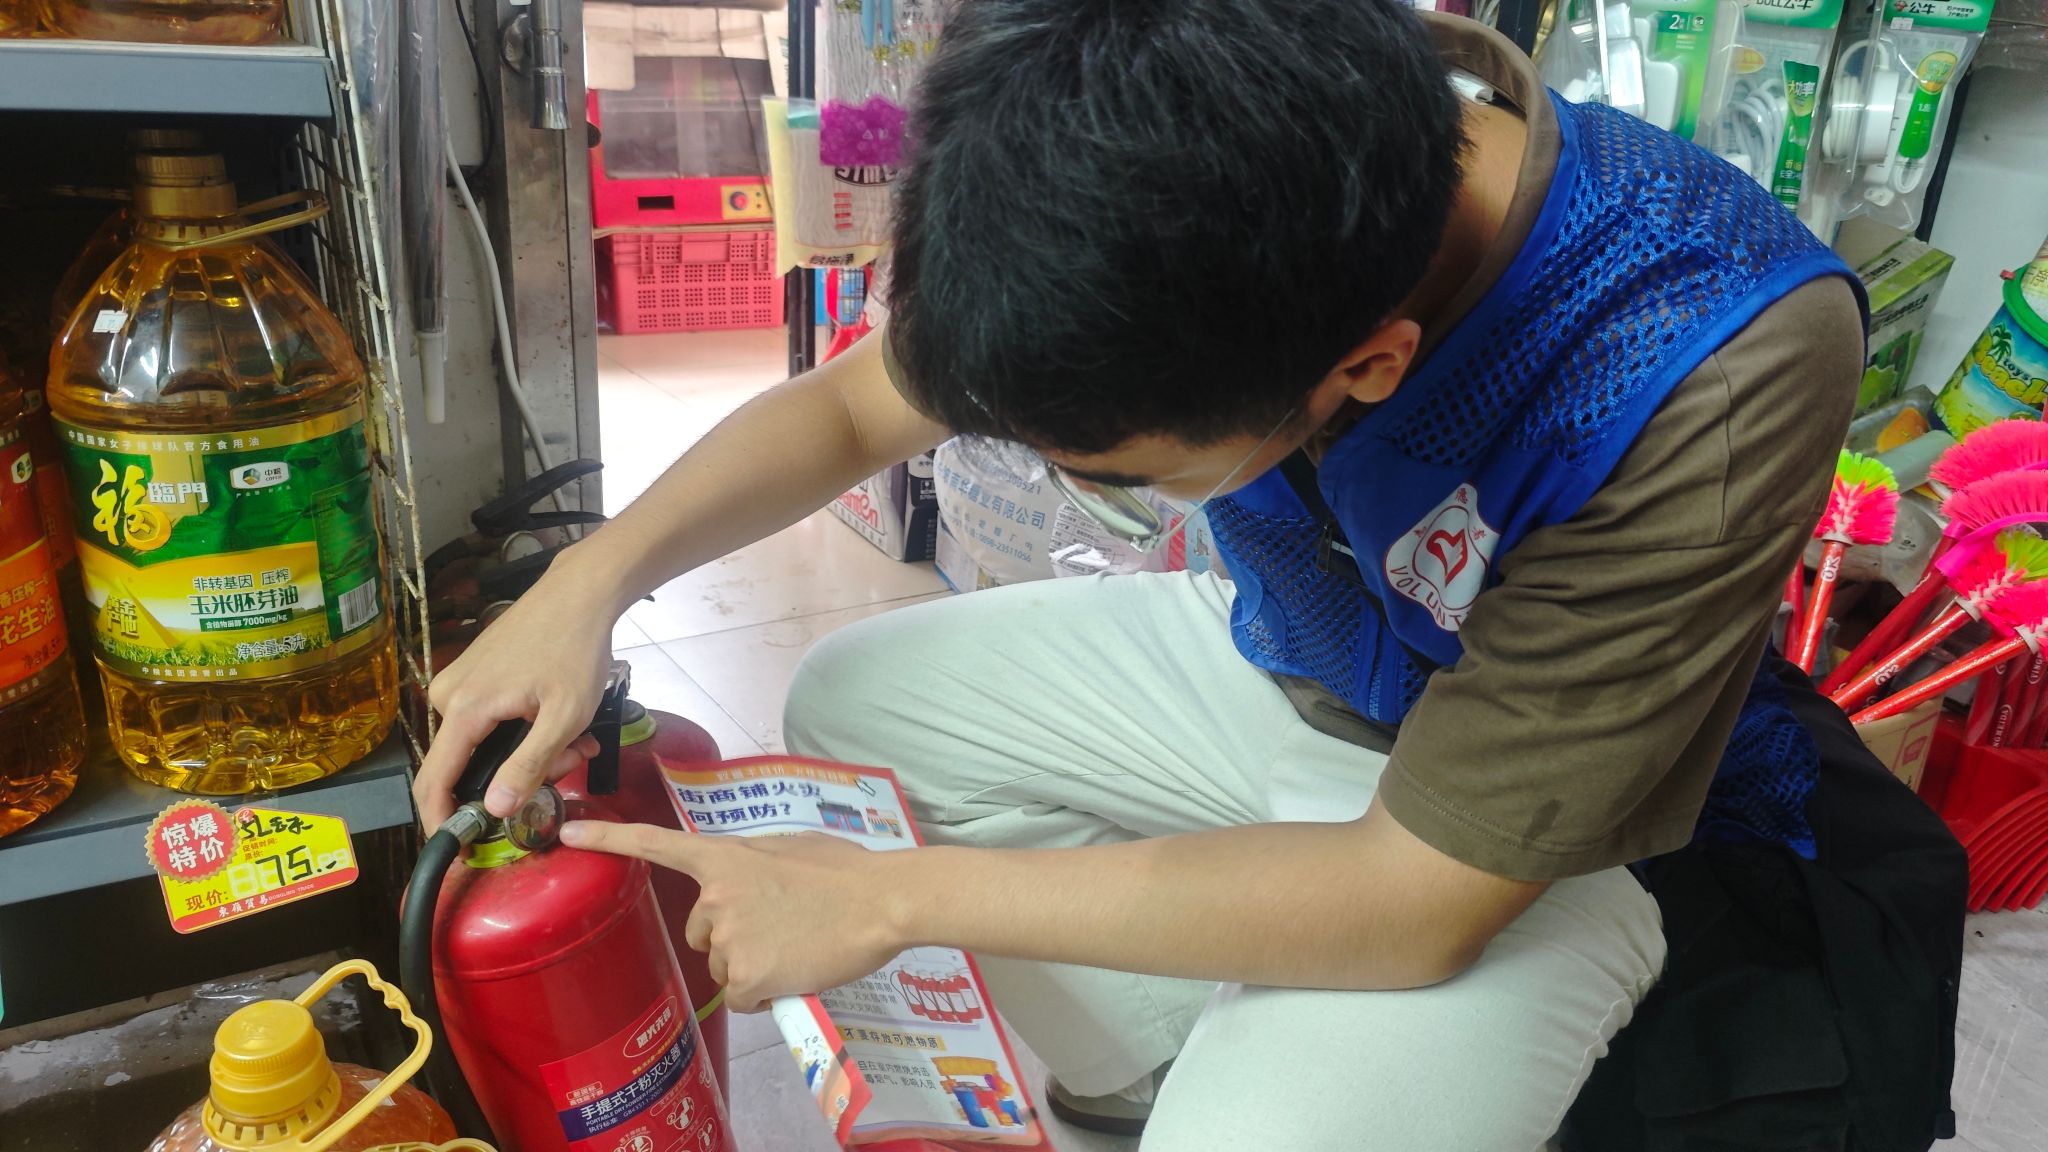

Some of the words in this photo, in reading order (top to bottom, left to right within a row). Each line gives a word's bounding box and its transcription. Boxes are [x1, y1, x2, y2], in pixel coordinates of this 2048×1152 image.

[1909, 2, 1935, 14] 公牛
[2003, 357, 2031, 381] toys
[193, 574, 253, 592] 非转基因
[261, 568, 290, 586] 压榨
[188, 585, 299, 616] 玉米胚芽油
[1390, 565, 1466, 627] VOLUNT
[242, 613, 288, 627] 7000mg/kg
[161, 812, 219, 849] 惊爆
[169, 837, 225, 873] 特价
[185, 888, 229, 912] 现价:
[581, 1042, 681, 1120] 手提式干粉灭火器
